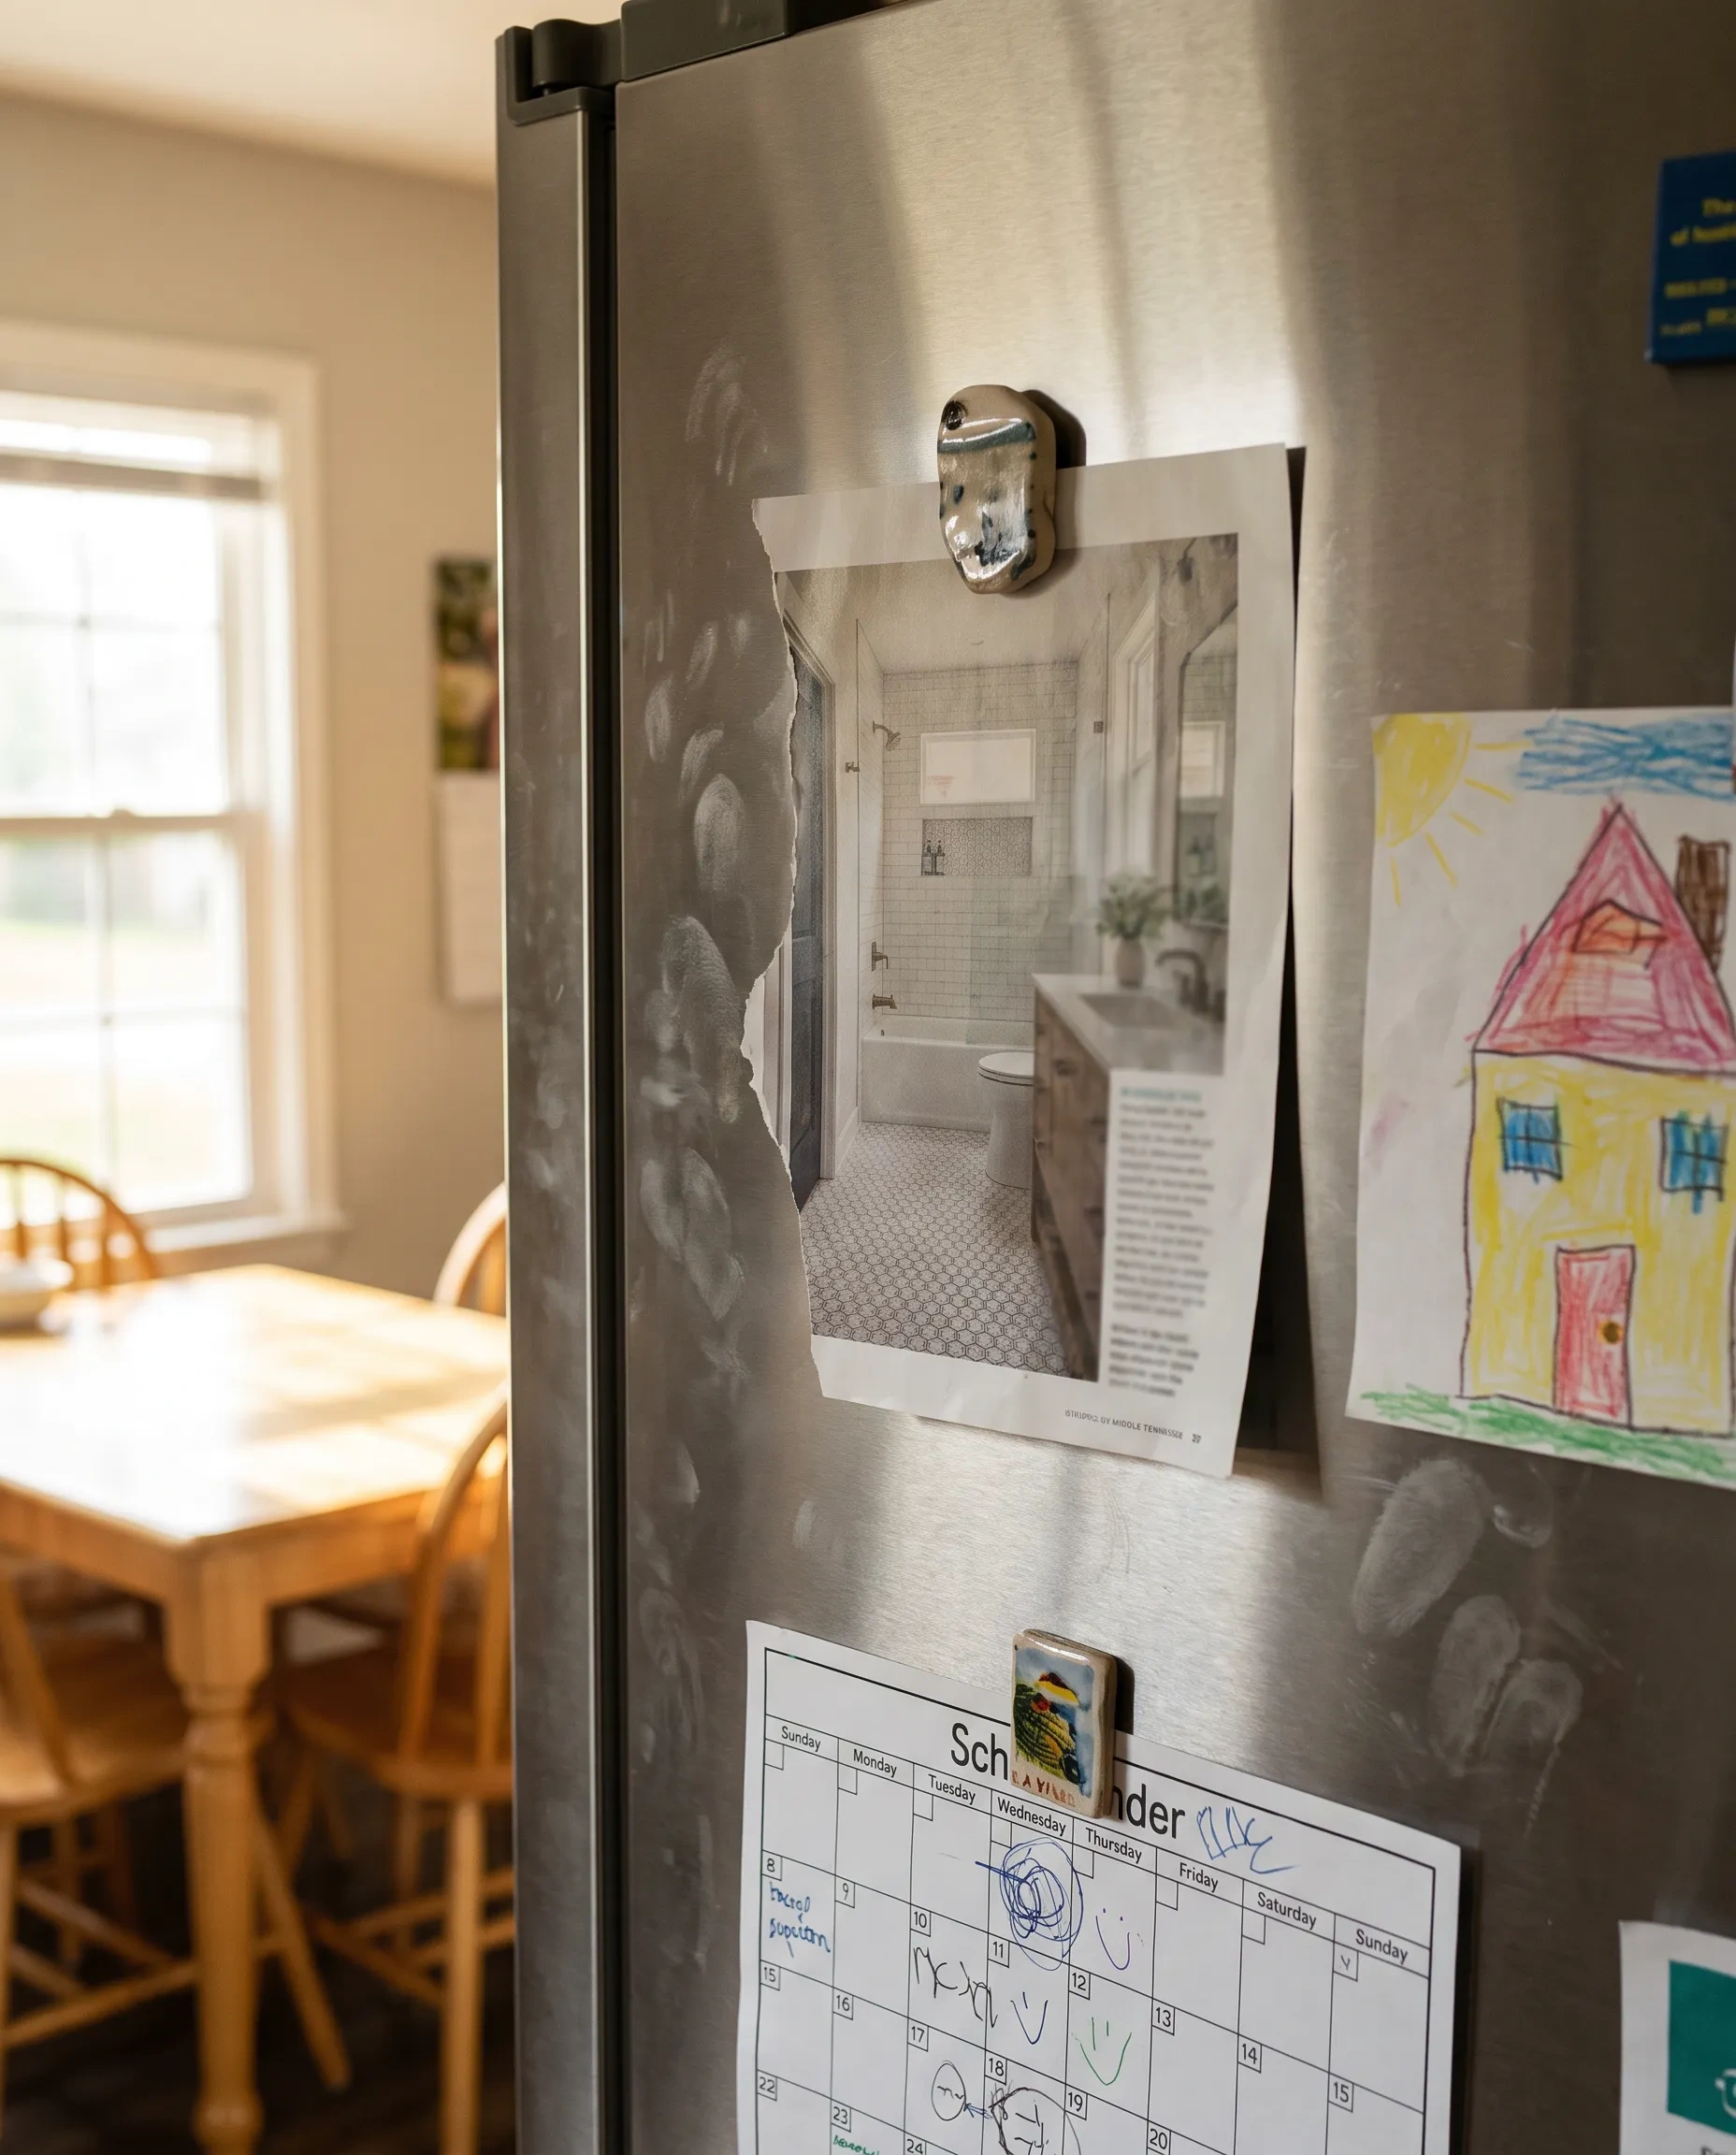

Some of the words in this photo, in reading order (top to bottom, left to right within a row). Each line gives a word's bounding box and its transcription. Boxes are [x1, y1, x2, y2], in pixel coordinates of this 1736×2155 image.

[950, 1723, 1008, 1781] Sch
[781, 1726, 821, 1753] Sunday
[853, 1748, 897, 1778] Monday
[928, 1773, 976, 1805] Tuesday
[997, 1797, 1066, 1836] Wednesday
[1085, 1827, 1142, 1863] Thursday
[1179, 1862, 1219, 1892] Friday
[1257, 1892, 1317, 1930] Saturday
[1355, 1929, 1409, 1964] Sunday
[763, 1967, 776, 1983] 15
[835, 1995, 850, 2012] 16
[911, 2026, 925, 2043] 17
[989, 2058, 1005, 2076] 18
[1067, 2092, 1083, 2112] 19
[1149, 2129, 1167, 2150] 20
[766, 1859, 775, 1873] 8
[842, 1884, 849, 1901] 9
[913, 1914, 927, 1929] 10
[992, 1941, 1004, 1959] 11
[1071, 1973, 1087, 1991] 12
[1155, 2007, 1172, 2028] 13
[1241, 2044, 1258, 2064] 14
[1333, 2082, 1350, 2104] 15
[759, 2076, 775, 2094] 22
[832, 2105, 848, 2125] 23
[906, 2138, 923, 2155] 24
